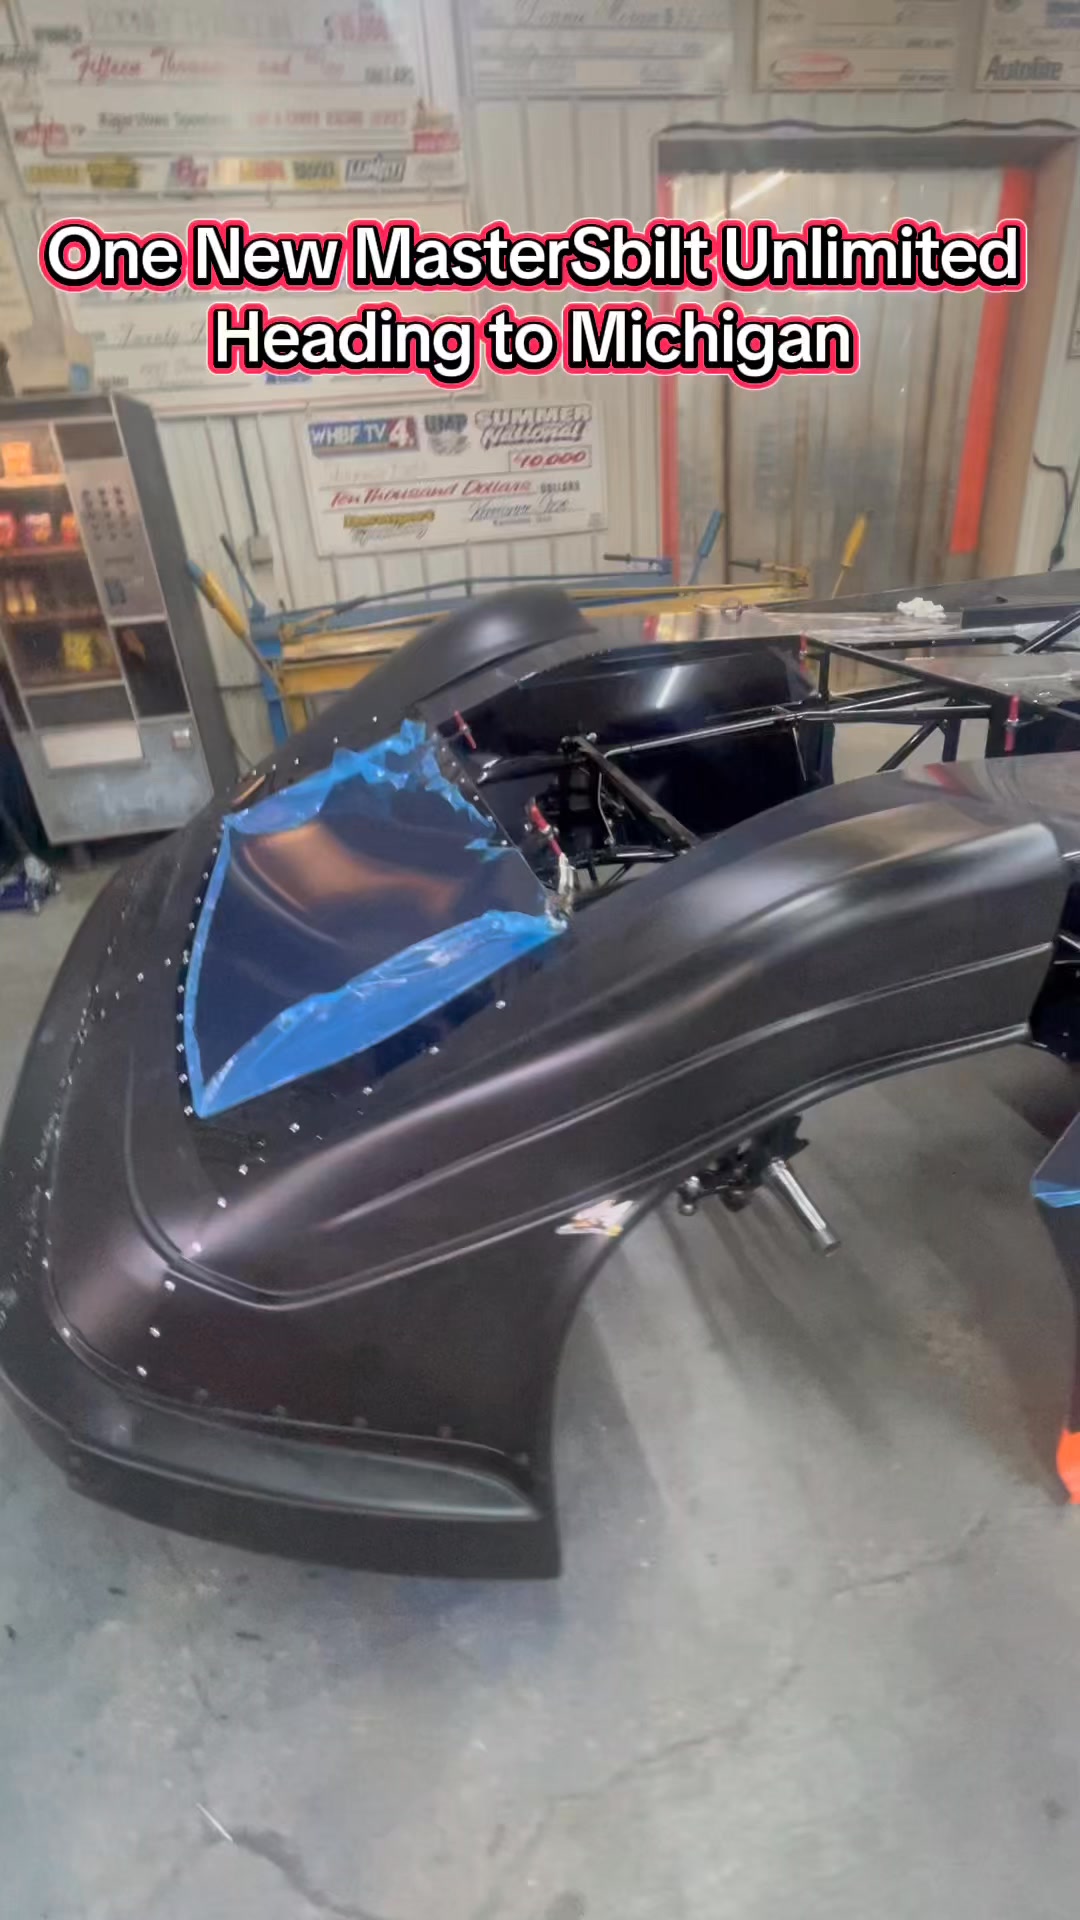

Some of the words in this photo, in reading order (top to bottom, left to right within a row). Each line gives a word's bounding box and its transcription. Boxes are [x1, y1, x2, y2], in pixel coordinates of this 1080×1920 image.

[475, 404, 592, 430] SUMMER
[363, 480, 459, 505] Thousand
[462, 478, 533, 497] Dollars
